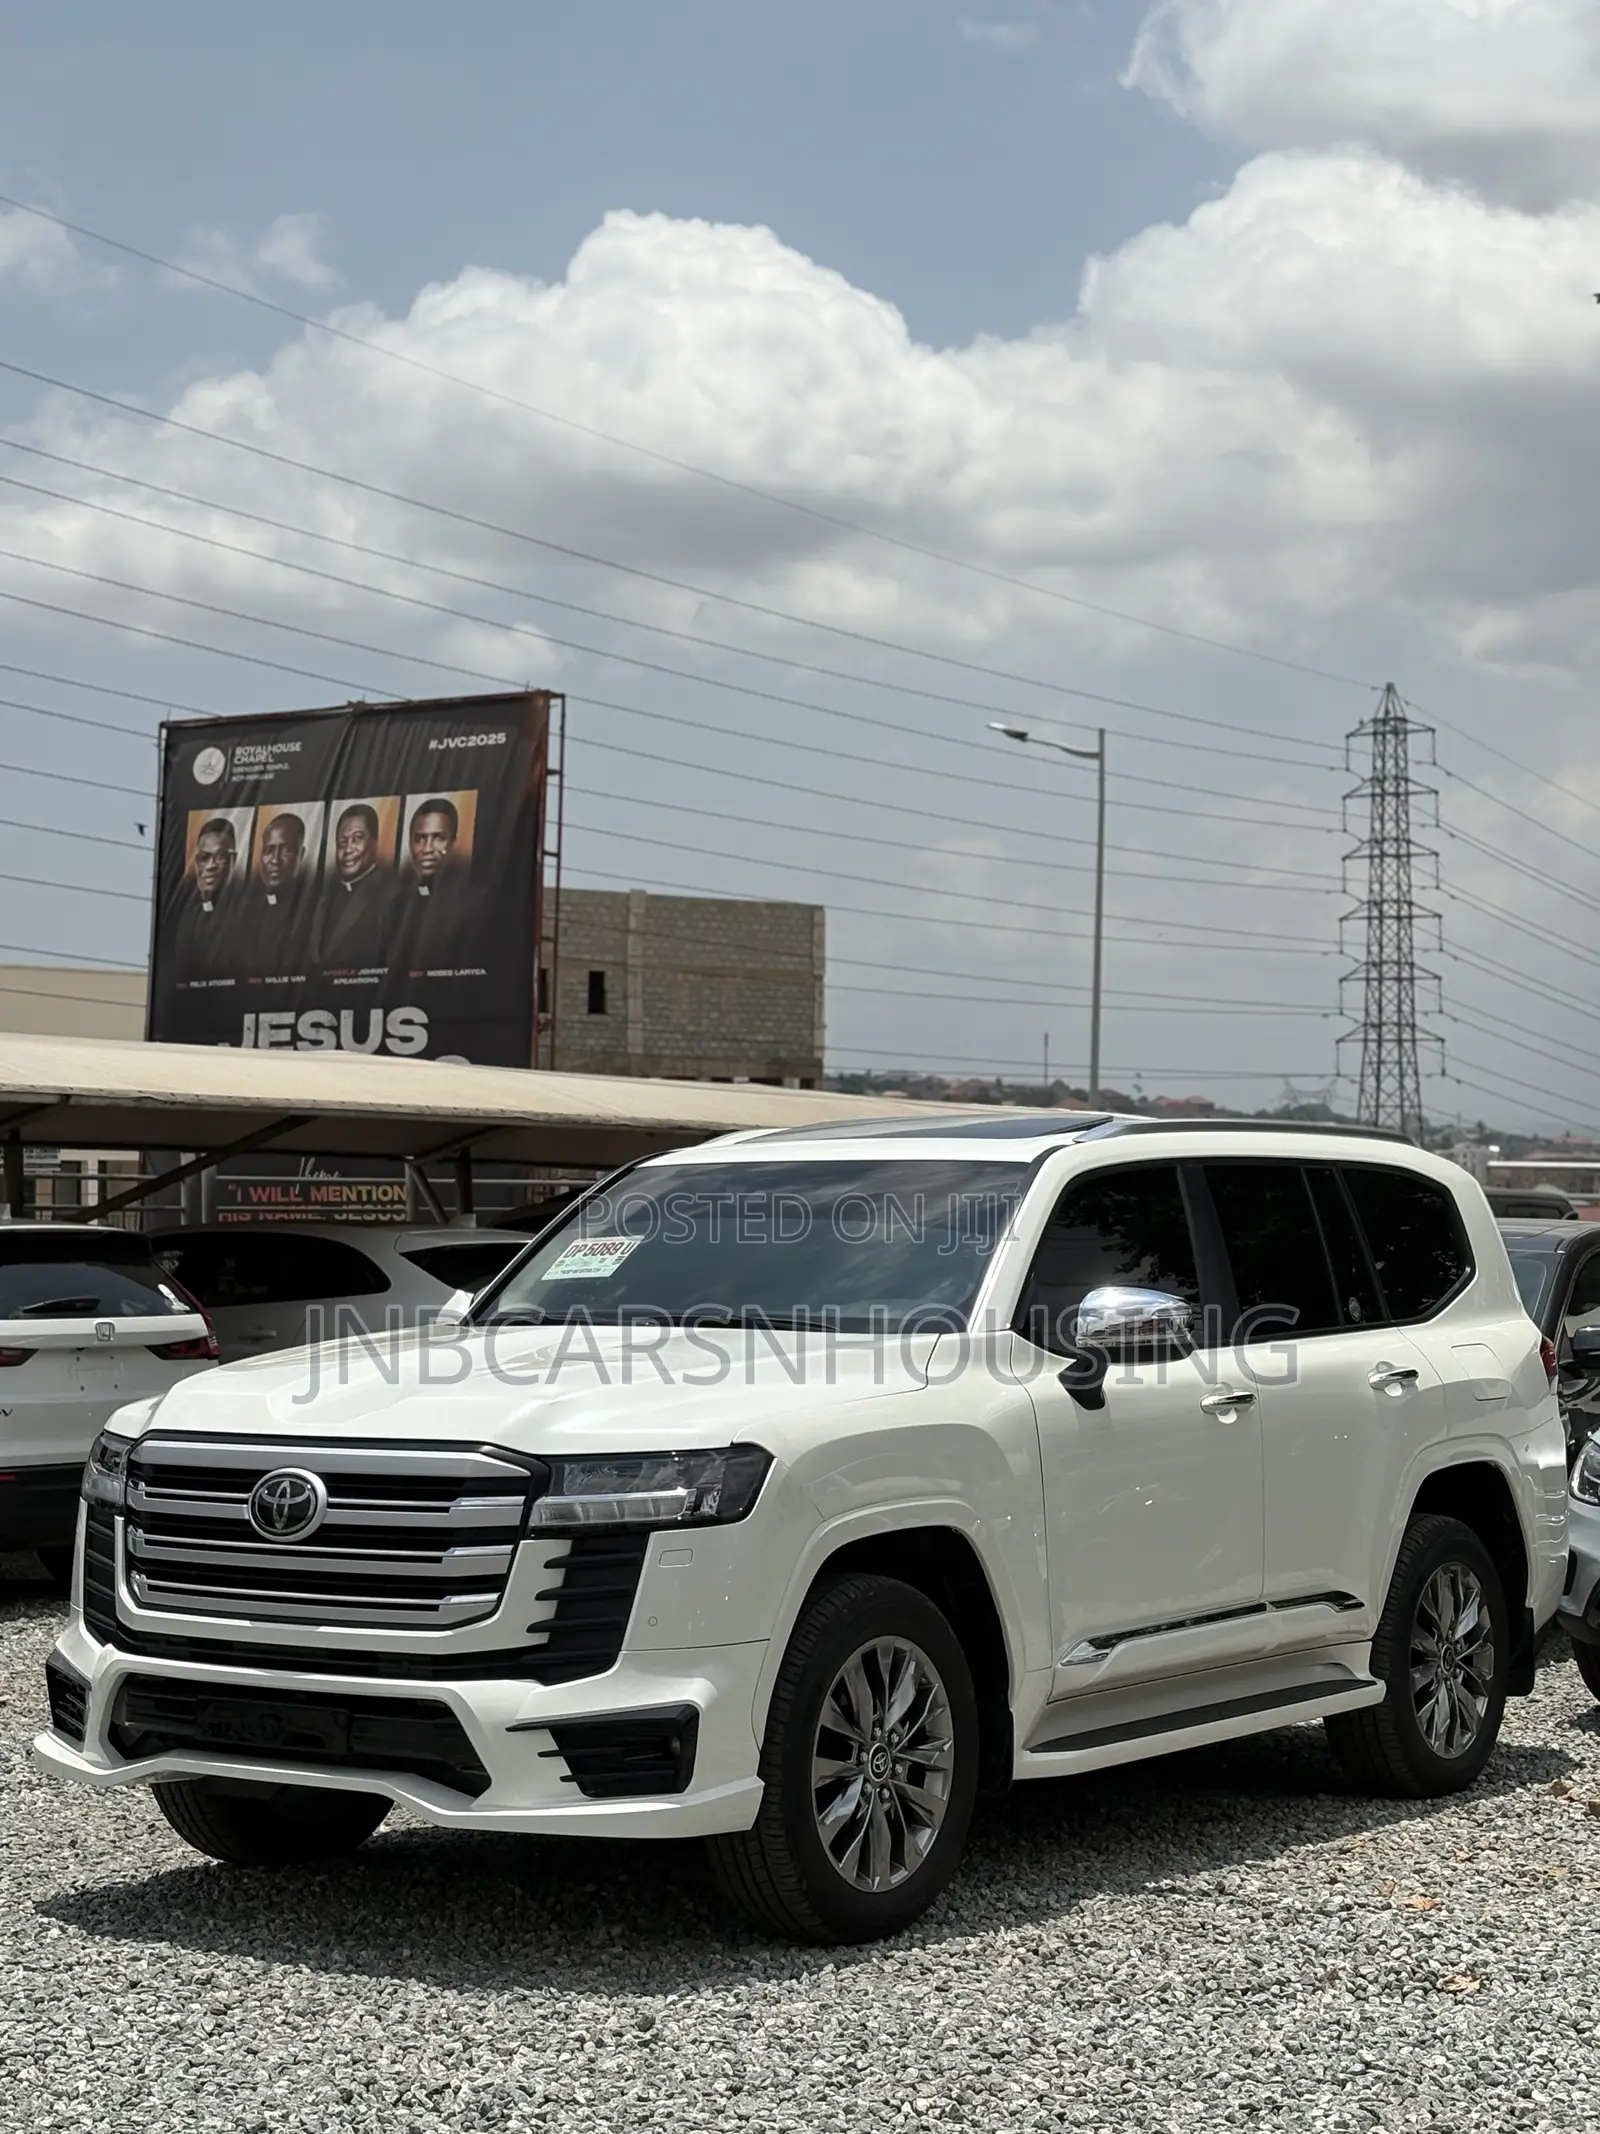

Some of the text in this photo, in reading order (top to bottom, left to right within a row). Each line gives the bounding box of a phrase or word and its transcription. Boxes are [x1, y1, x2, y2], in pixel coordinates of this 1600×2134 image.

[235, 741, 303, 757] ROYALHOUSE
[429, 732, 506, 750] #JVC2025
[234, 754, 274, 765] CHAPEL
[290, 975, 306, 983] VAN
[240, 1006, 429, 1055] JESUS
[248, 1185, 304, 1203] WILL
[310, 1184, 406, 1203] MENTION
